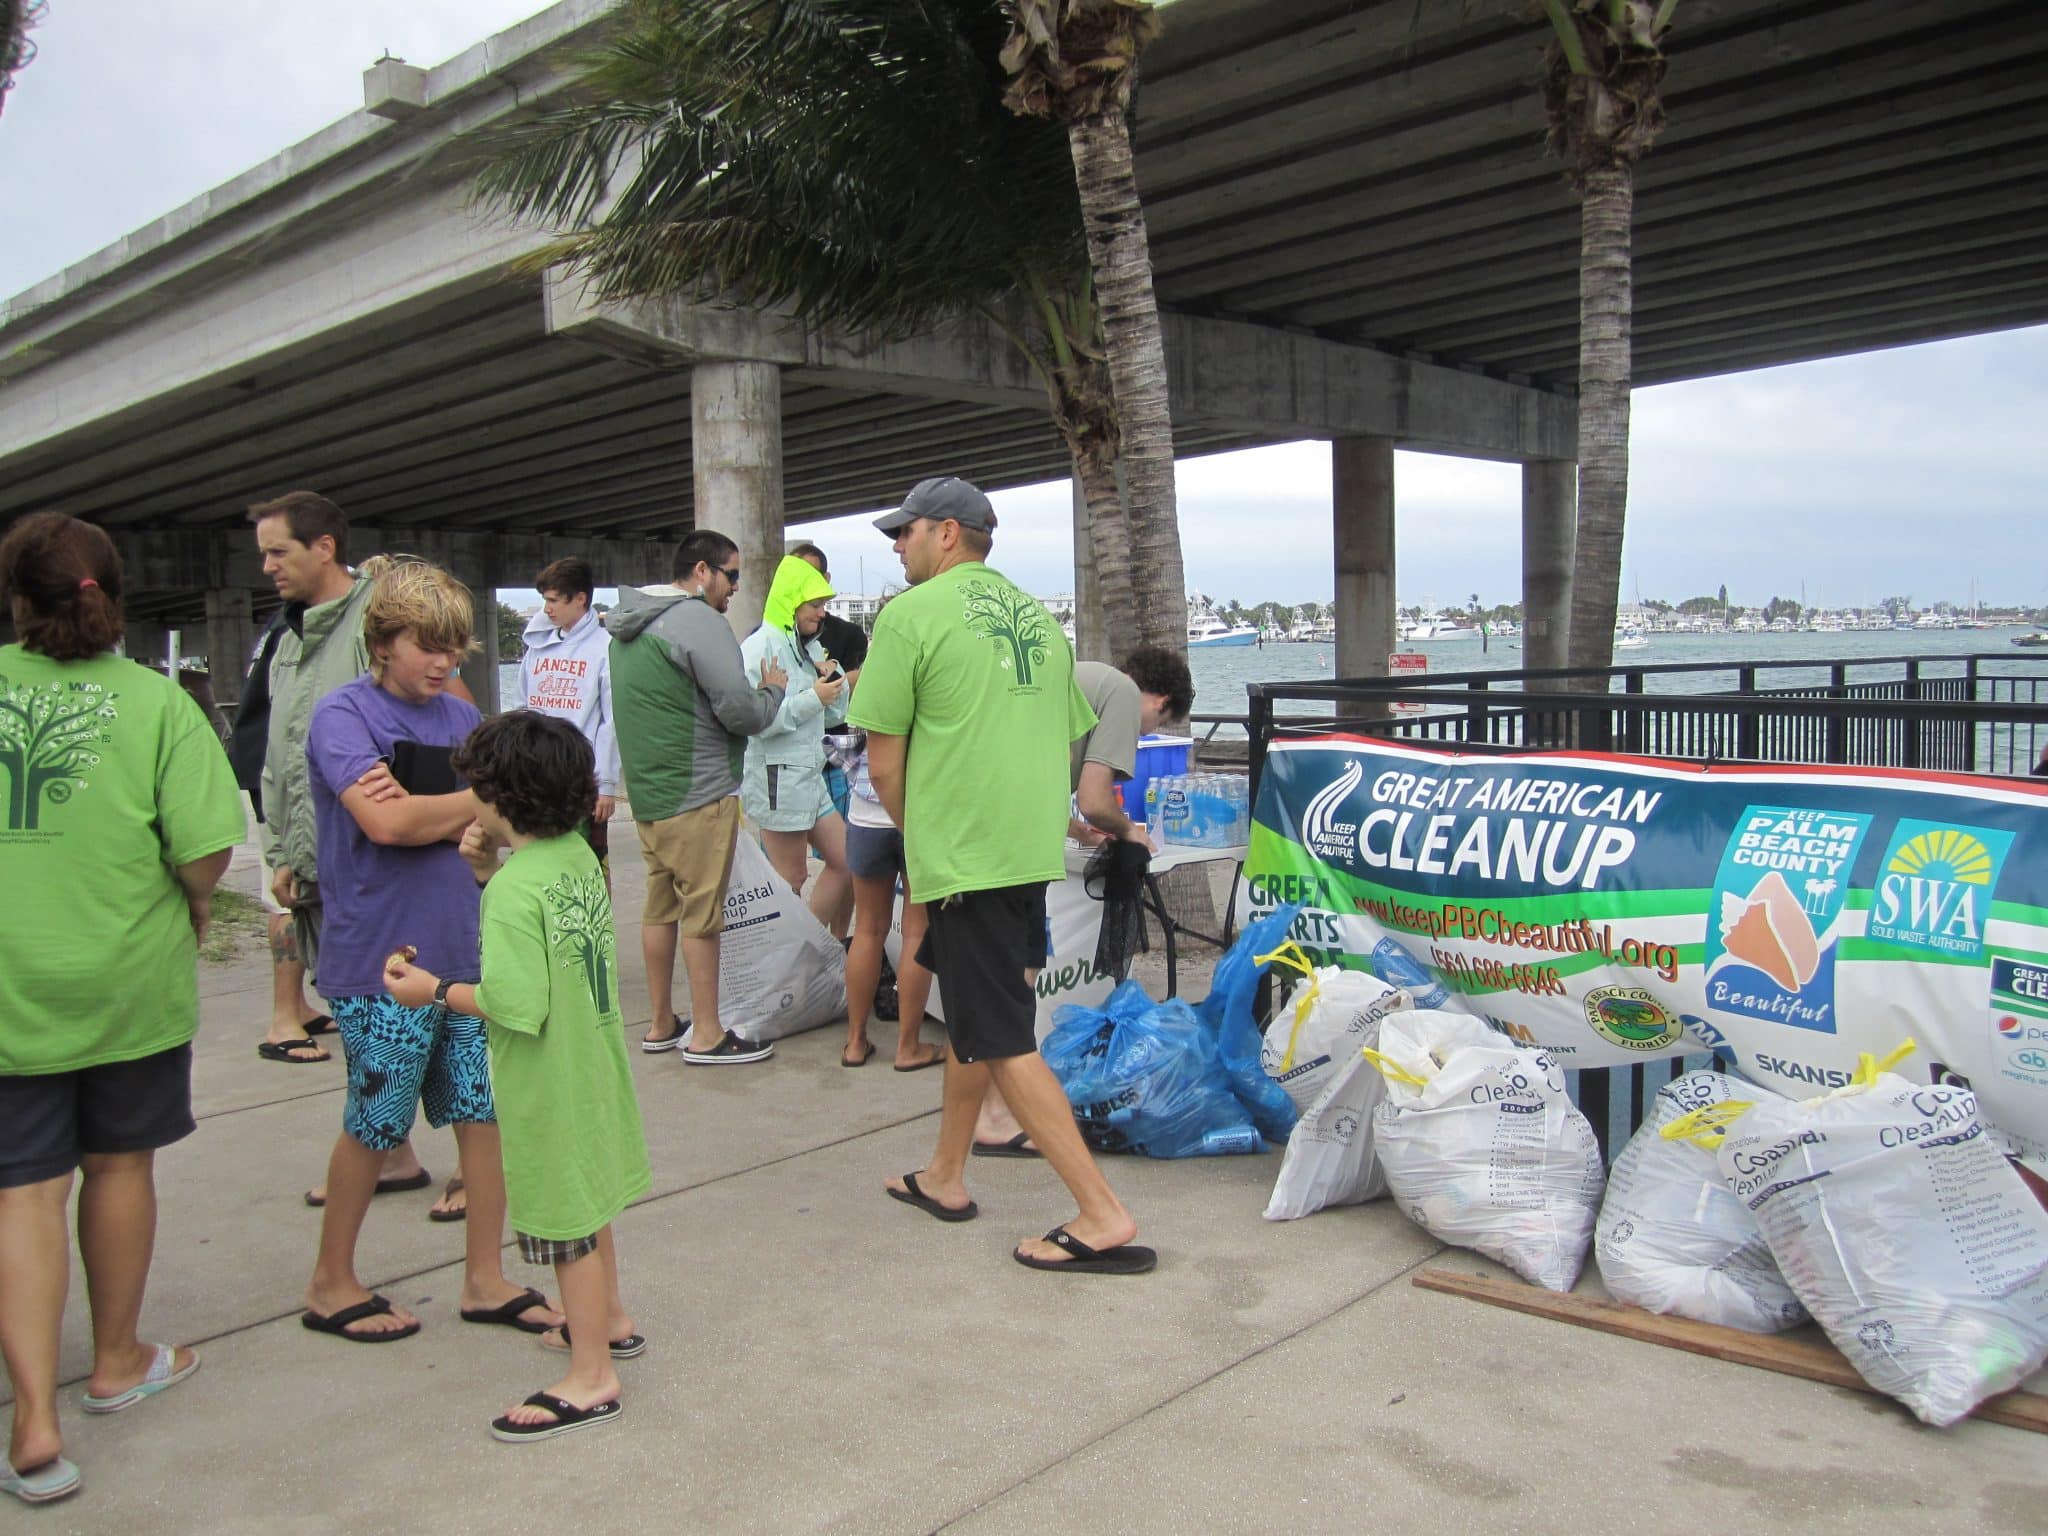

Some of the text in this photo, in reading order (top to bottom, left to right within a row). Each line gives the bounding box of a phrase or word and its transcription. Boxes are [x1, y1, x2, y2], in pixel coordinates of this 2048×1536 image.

[533, 657, 588, 678] LANCER
[1372, 771, 1663, 824] GREAT AMERICAN
[1332, 822, 1356, 834] KEEP
[1746, 817, 1858, 841] PALM
[1787, 810, 1826, 822] KEEP
[1316, 833, 1354, 846] AMERICA
[1358, 808, 1636, 890] CLEANUP
[1738, 832, 1850, 858] BEACH
[1733, 848, 1846, 876] COUNTY
[1248, 873, 1331, 909] GREEN
[1872, 873, 1980, 940] SWA
[1871, 925, 1979, 953] SOLID WASTE AUTHORITY
[1472, 956, 1566, 997] 686-6646
[2011, 977, 2048, 1000] CLE
[1591, 988, 1627, 1001] BEACH
[1714, 981, 1830, 1023] Beautiful
[1755, 1053, 1853, 1089] SKANS
